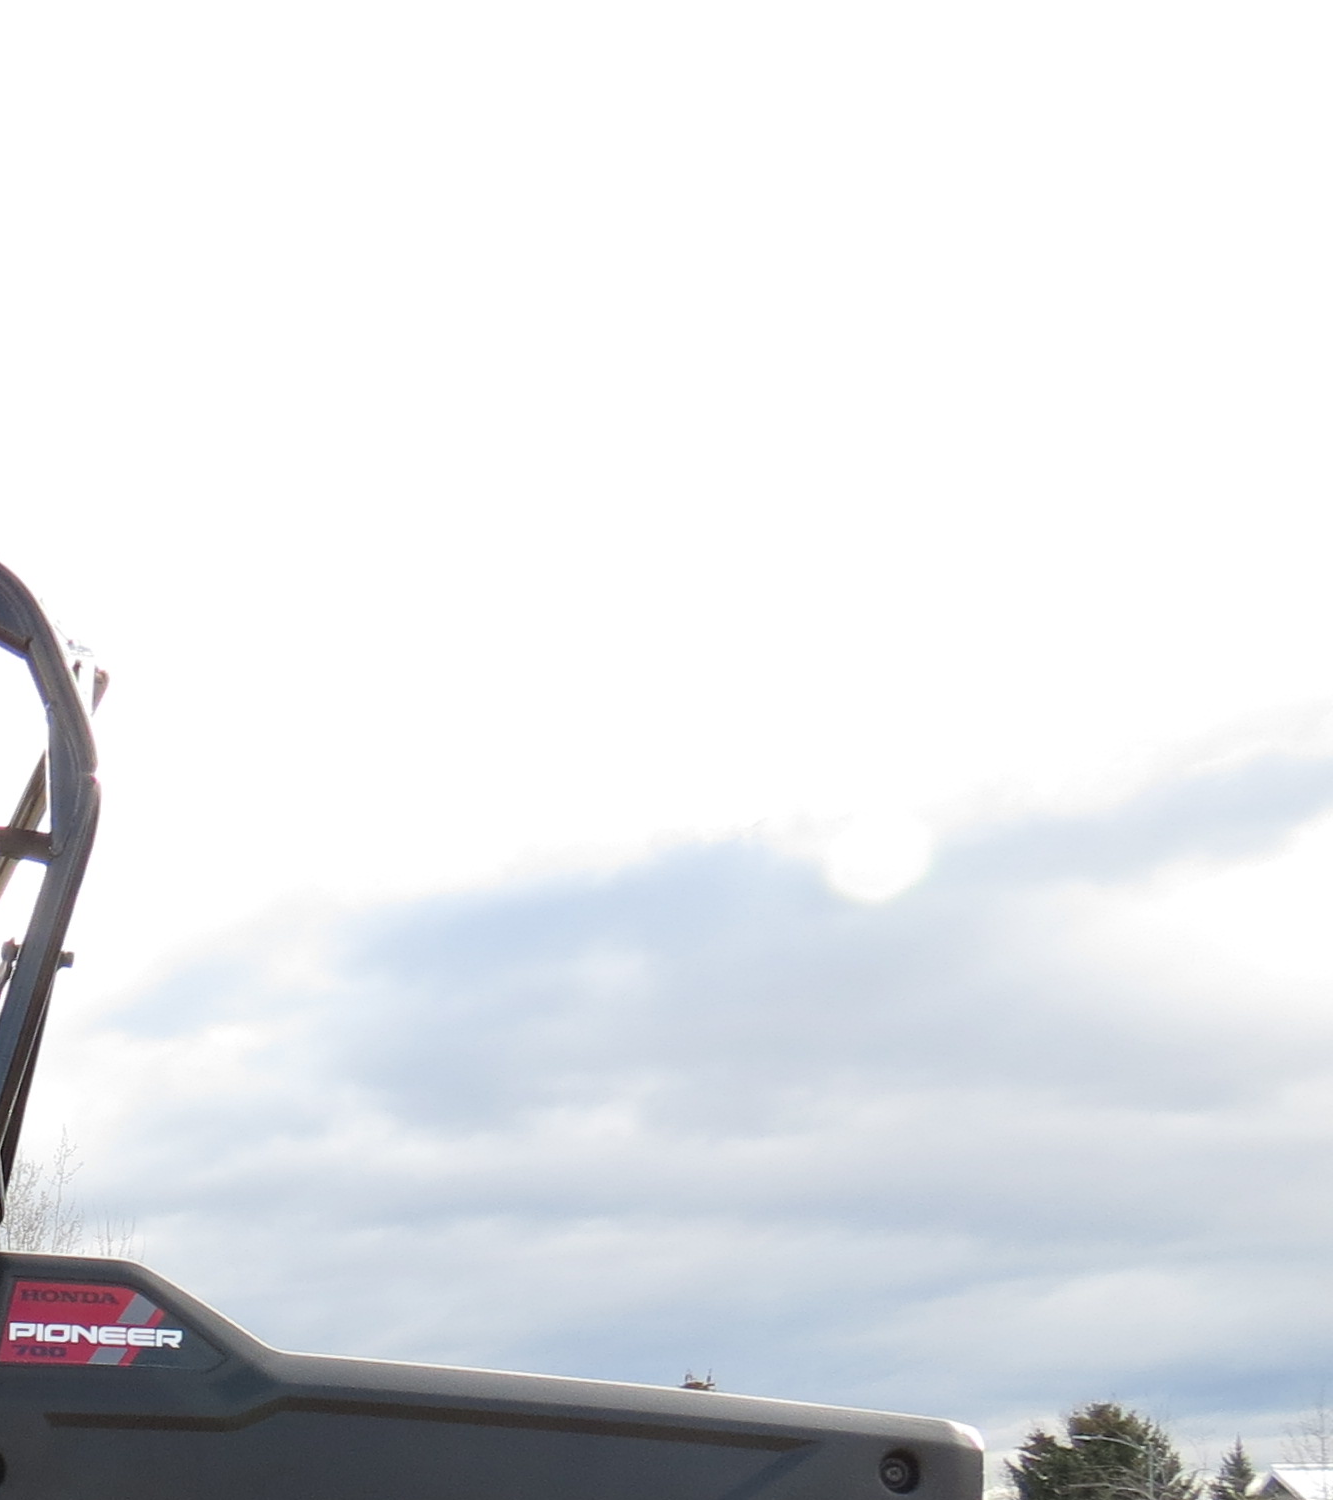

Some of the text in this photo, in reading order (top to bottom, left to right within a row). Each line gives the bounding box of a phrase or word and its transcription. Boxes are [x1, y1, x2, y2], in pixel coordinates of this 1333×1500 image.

[20, 1289, 119, 1305] HONDA
[9, 1322, 182, 1348] PIONEER
[13, 1344, 66, 1357] 700
